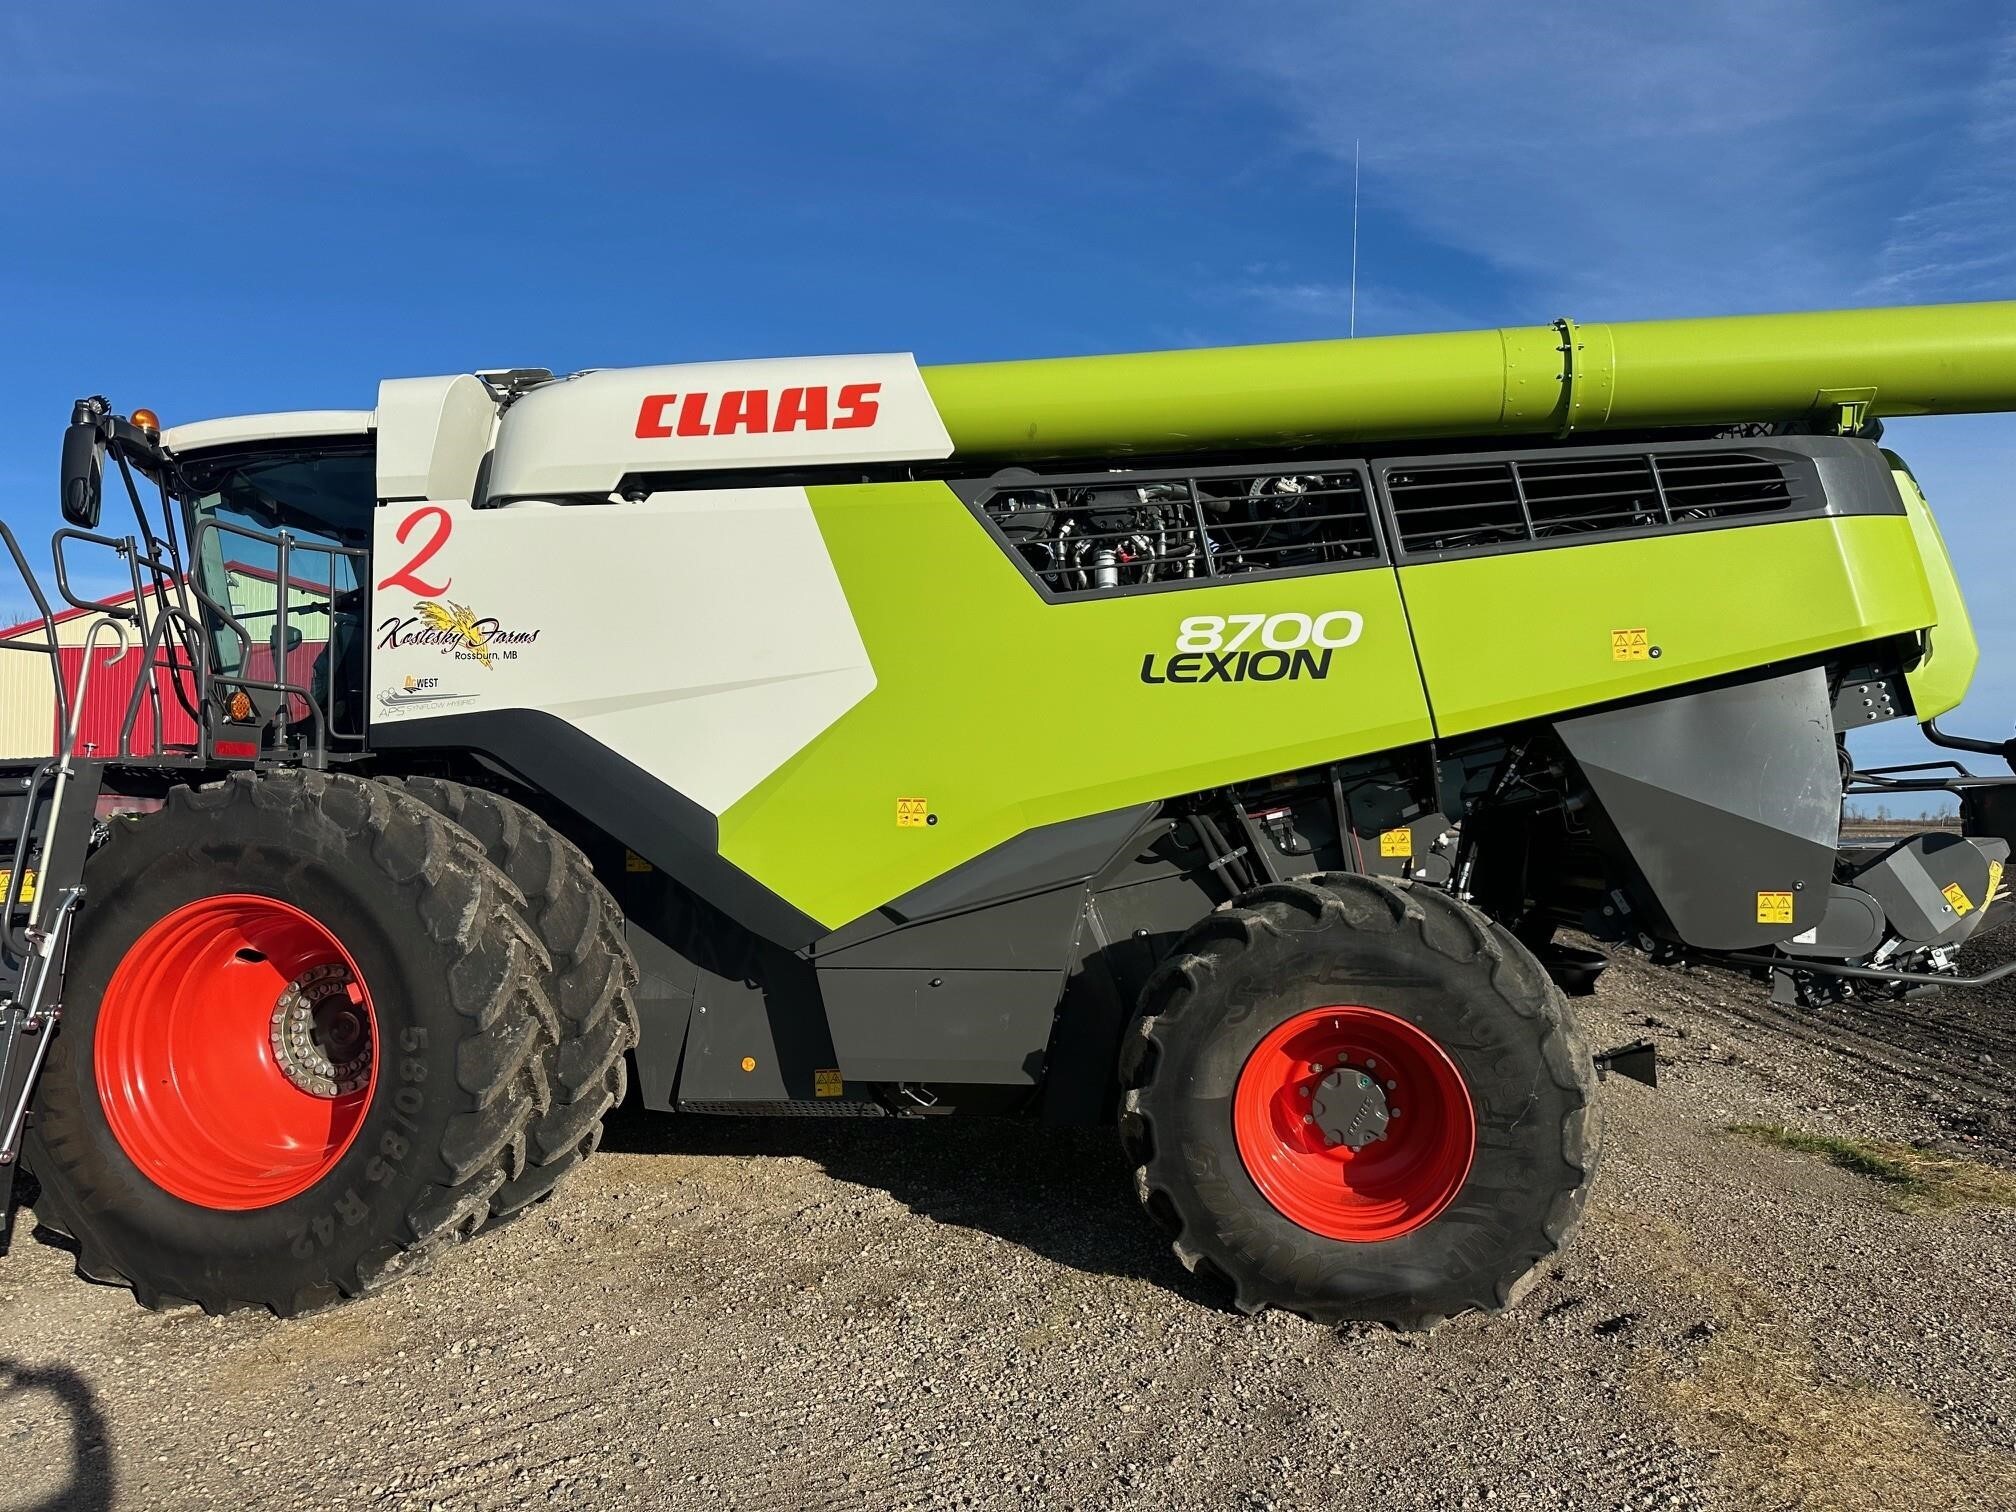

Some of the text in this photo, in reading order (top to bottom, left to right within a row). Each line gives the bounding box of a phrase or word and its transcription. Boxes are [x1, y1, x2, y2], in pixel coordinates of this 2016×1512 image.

[635, 383, 882, 438] CLAAS
[377, 506, 452, 598] 2
[377, 617, 540, 654] Kostesky Farms
[1176, 610, 1364, 652] 8700
[455, 650, 518, 661] Rossburn, MB
[1140, 648, 1333, 684] LEXION
[379, 706, 405, 718] APS
[366, 1026, 429, 1188] 580/85
